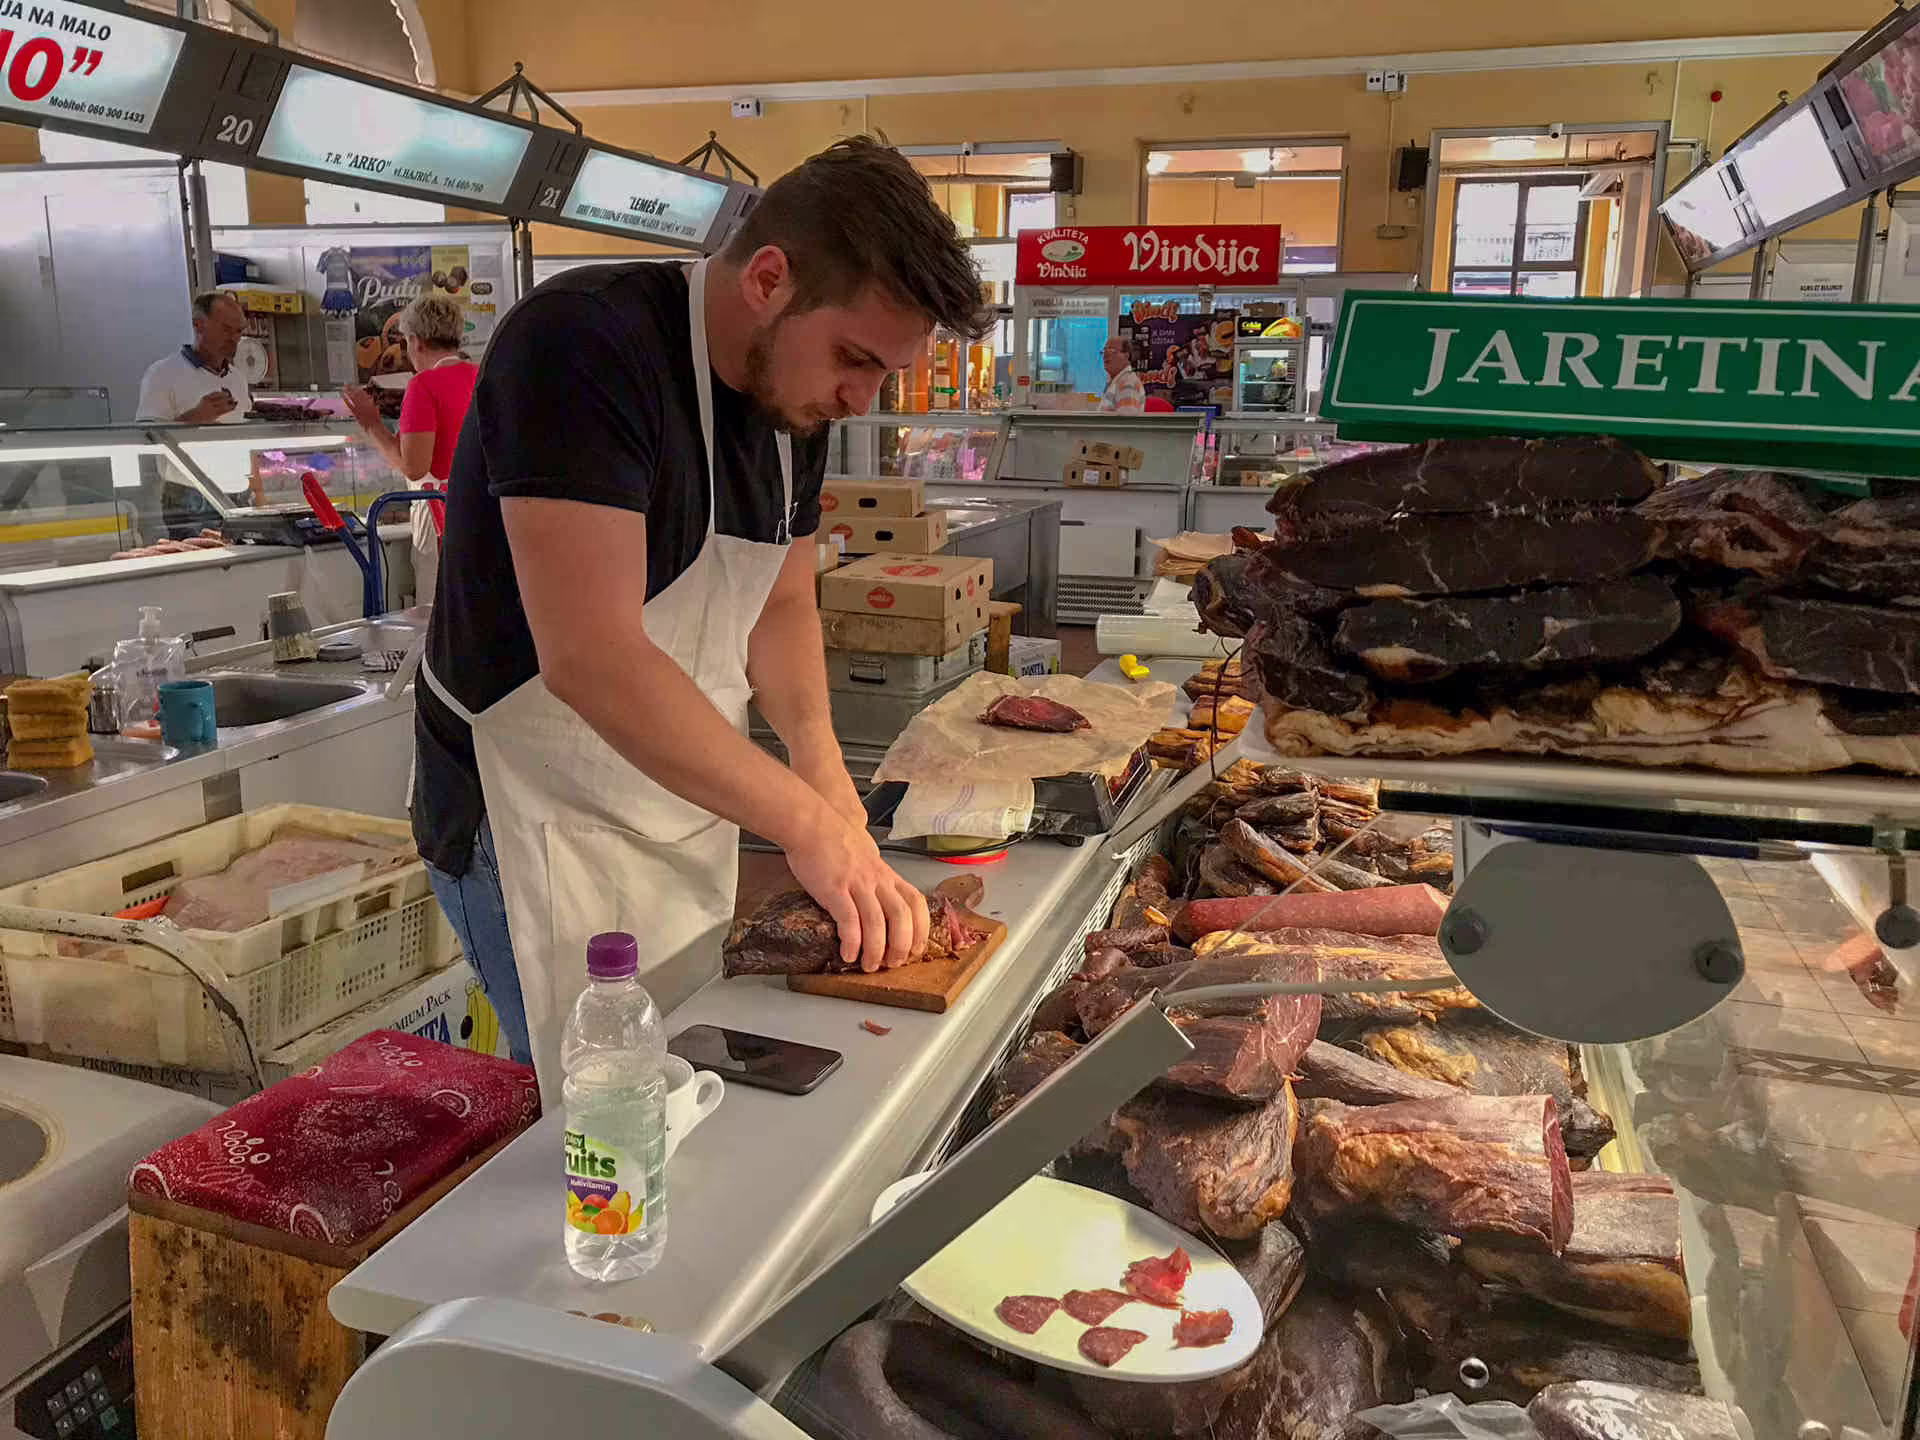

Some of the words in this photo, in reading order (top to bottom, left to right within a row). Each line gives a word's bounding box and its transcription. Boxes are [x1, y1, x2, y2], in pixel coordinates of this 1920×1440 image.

[0, 0, 22, 19] JA
[28, 6, 54, 27] NA
[59, 14, 111, 40] MALO
[48, 96, 87, 113] Mobitel:
[216, 114, 253, 145] 20
[346, 152, 392, 173] "ARKO"
[540, 187, 561, 208] 21
[1037, 229, 1089, 245] KVALITETA
[1122, 230, 1260, 275] Vindija
[1036, 261, 1088, 279] Vindija
[160, 1067, 201, 1087] PACK
